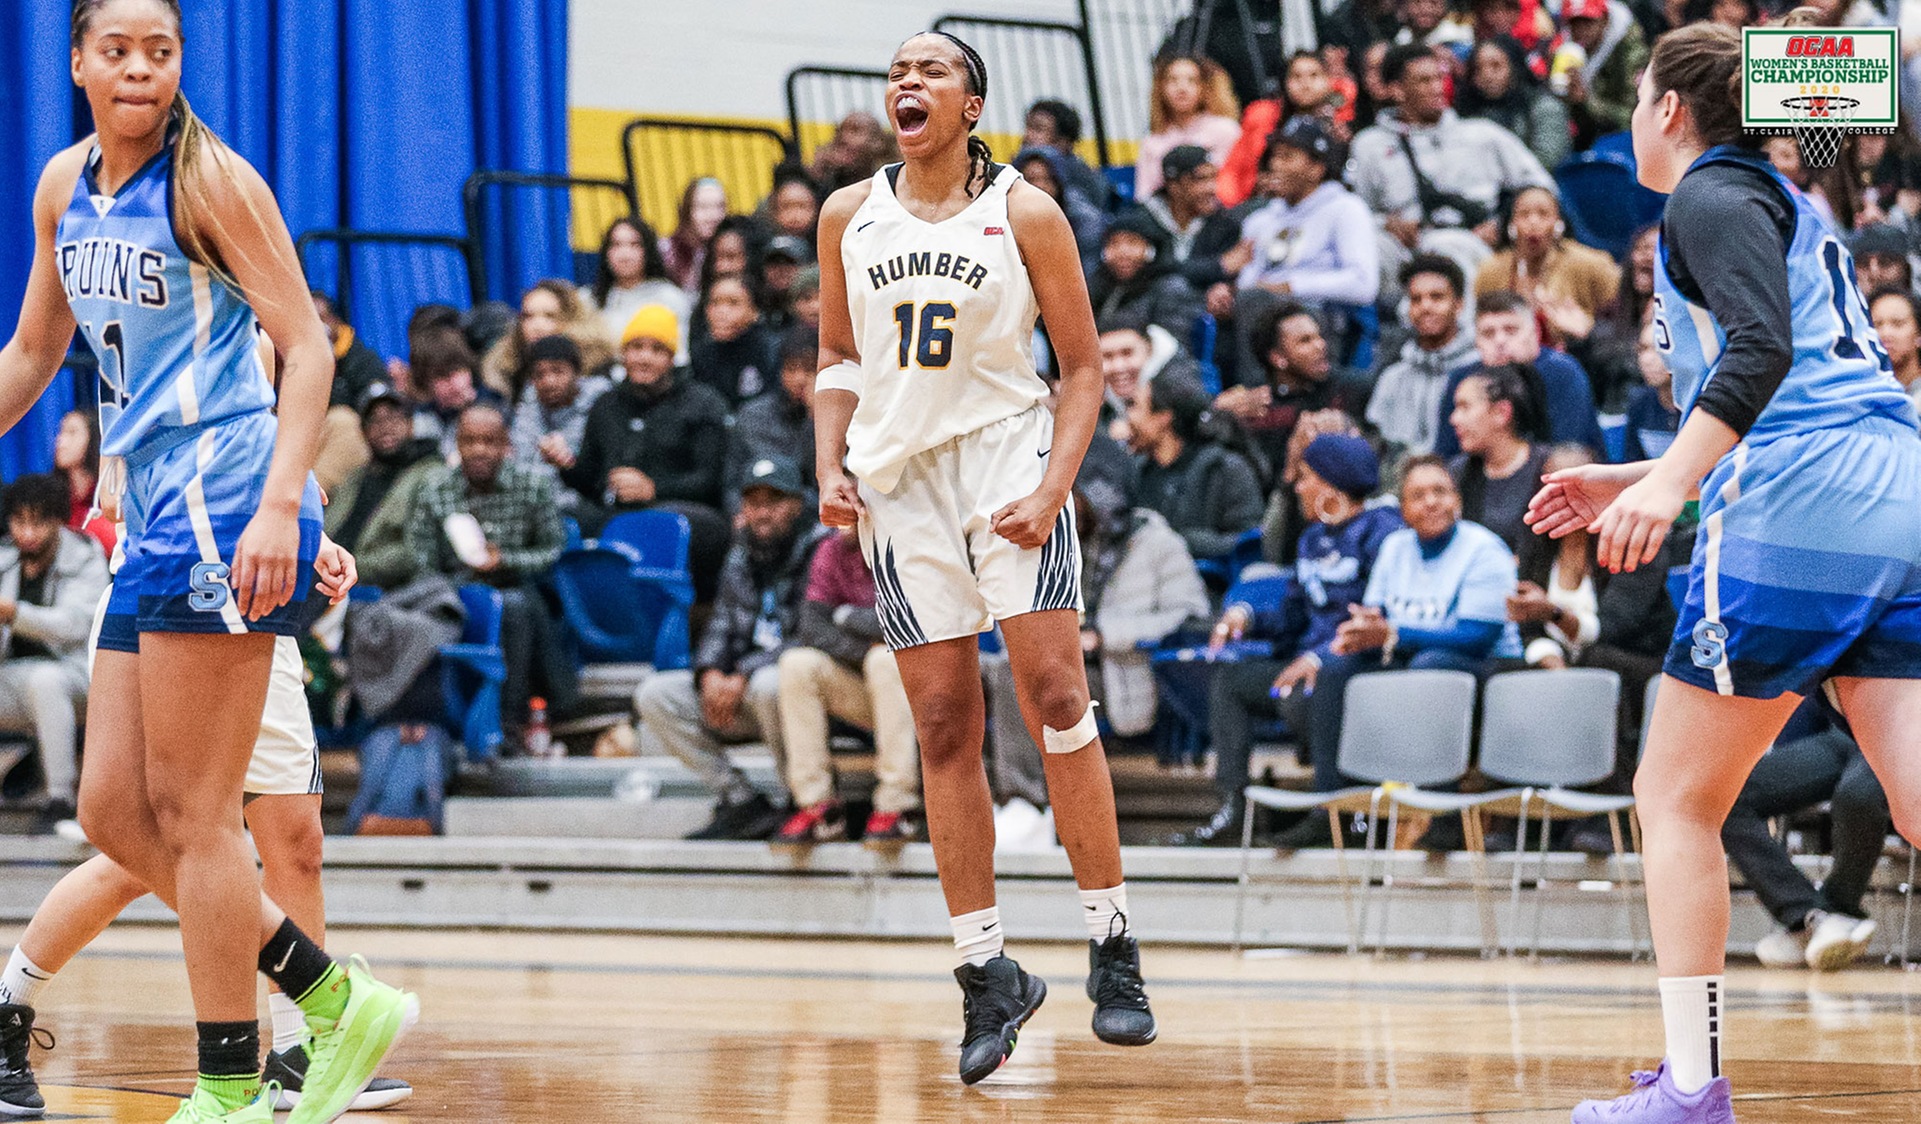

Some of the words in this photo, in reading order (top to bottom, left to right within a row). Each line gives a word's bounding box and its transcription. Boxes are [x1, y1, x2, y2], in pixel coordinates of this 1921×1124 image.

[867, 251, 988, 291] HUMBER
[892, 300, 959, 370] 16
[188, 561, 231, 612] S
[1690, 617, 1729, 670] S
